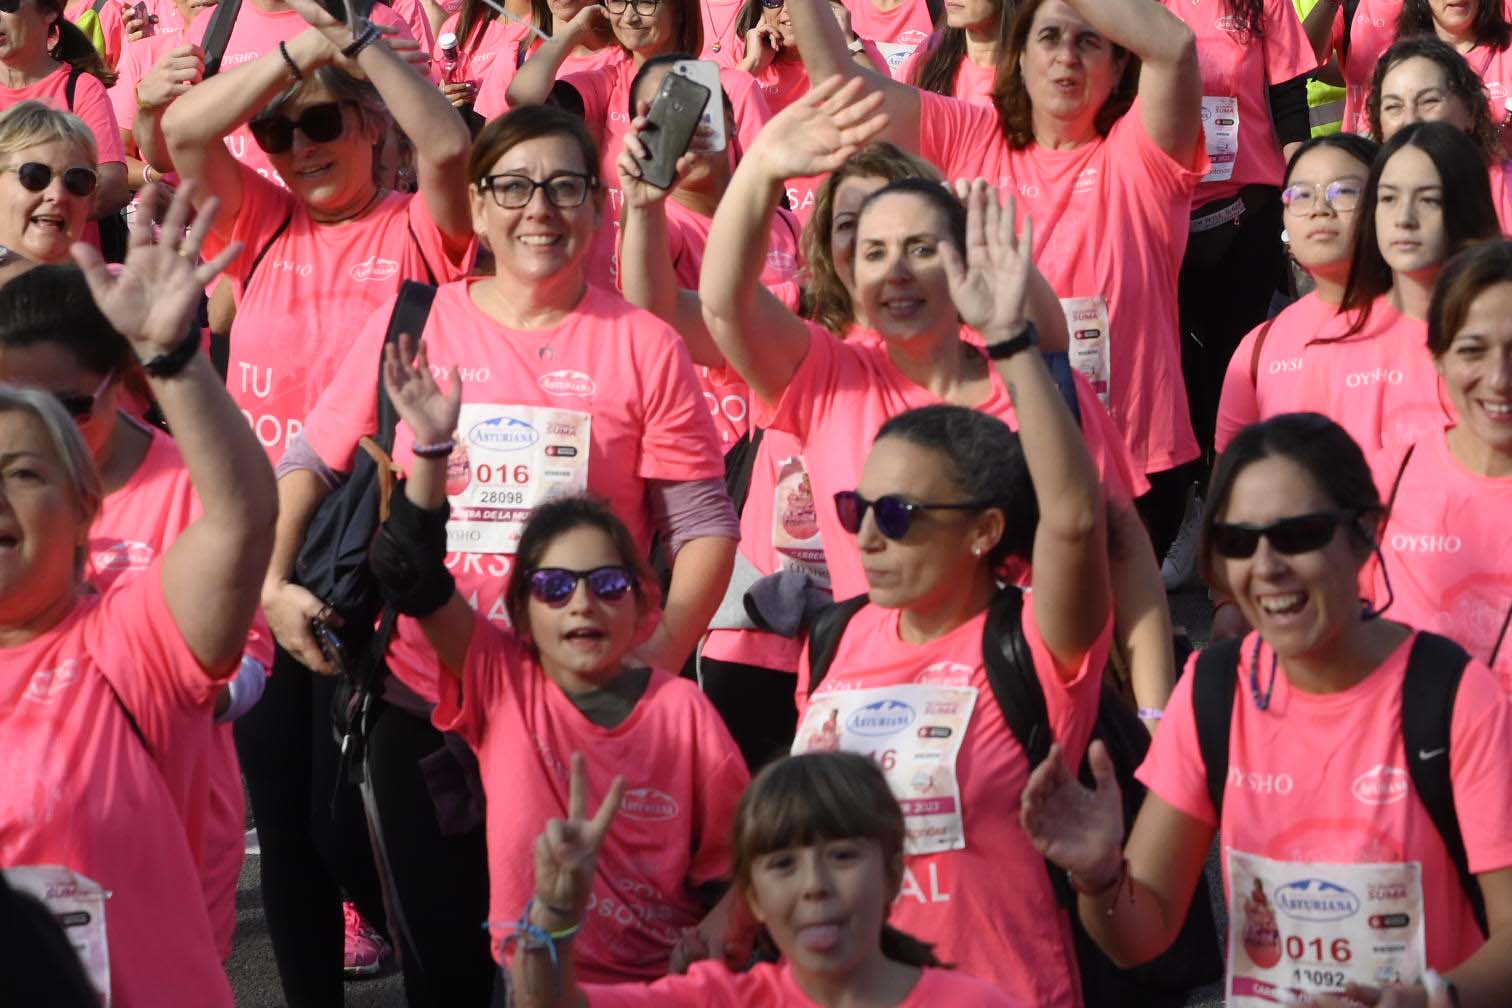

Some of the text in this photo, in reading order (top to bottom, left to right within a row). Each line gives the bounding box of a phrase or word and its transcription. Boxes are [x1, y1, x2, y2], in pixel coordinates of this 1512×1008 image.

[786, 188, 816, 210] SA
[240, 360, 273, 398] TU
[477, 428, 535, 442] ASTURIANA
[476, 463, 530, 485] 016
[480, 491, 524, 505] 28098
[483, 511, 497, 520] DE
[498, 511, 511, 520] LA
[513, 511, 529, 521] MU
[1391, 535, 1462, 554] OYSHO
[894, 863, 950, 904] AL
[1280, 894, 1353, 913] ASTURIANA
[1285, 935, 1353, 963] 016
